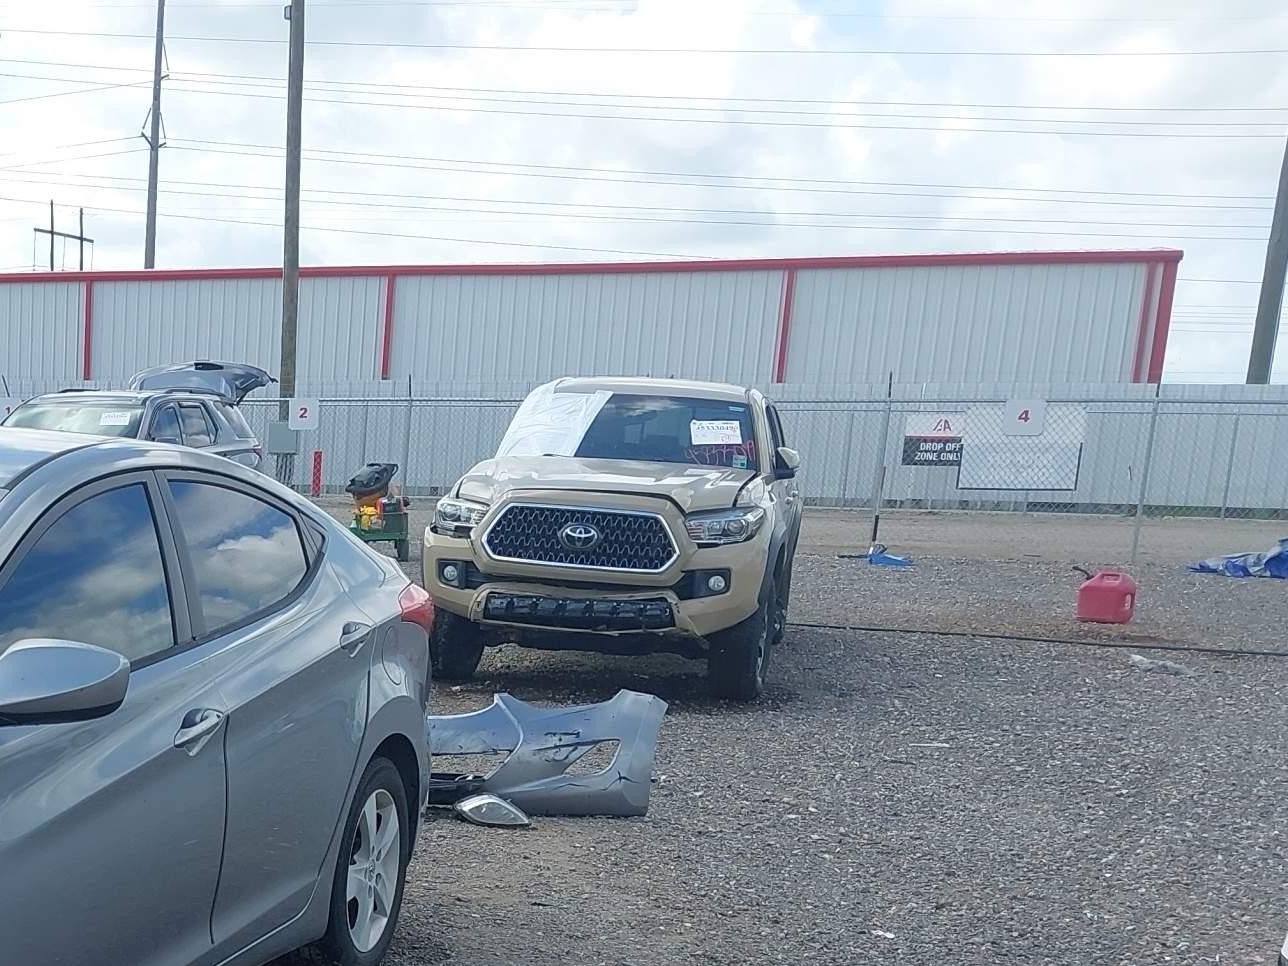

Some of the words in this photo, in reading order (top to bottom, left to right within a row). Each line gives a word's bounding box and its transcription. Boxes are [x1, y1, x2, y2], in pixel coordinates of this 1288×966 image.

[299, 407, 308, 418] 2
[1017, 410, 1031, 423] 4
[919, 442, 944, 451] DROP
[945, 442, 961, 451] OFF
[914, 452, 939, 461] ZONE
